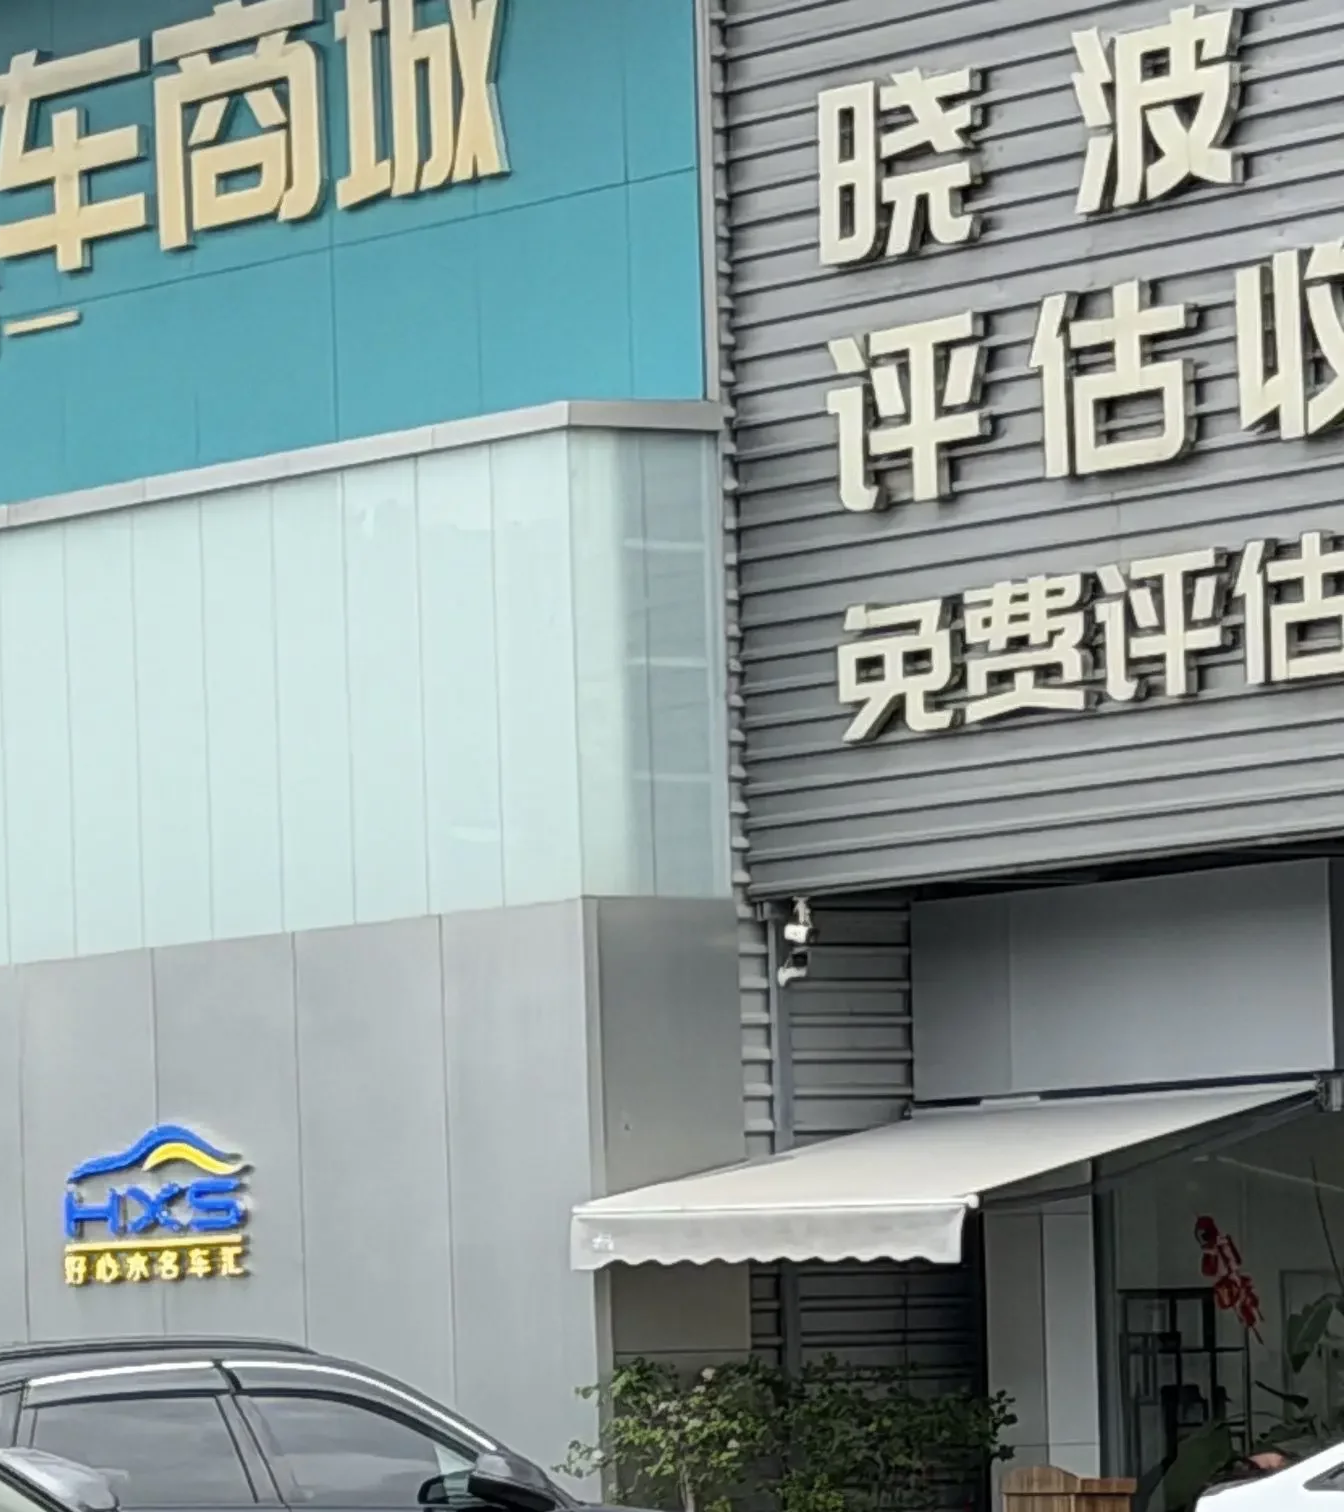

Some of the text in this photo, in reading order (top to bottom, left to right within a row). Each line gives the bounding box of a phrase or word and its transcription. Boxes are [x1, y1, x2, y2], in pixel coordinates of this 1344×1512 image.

[817, 5, 1240, 266] 晓波
[837, 531, 1344, 743] 免费评估
[64, 1177, 243, 1238] HXS
[64, 1247, 245, 1285] 好心水名车汇
